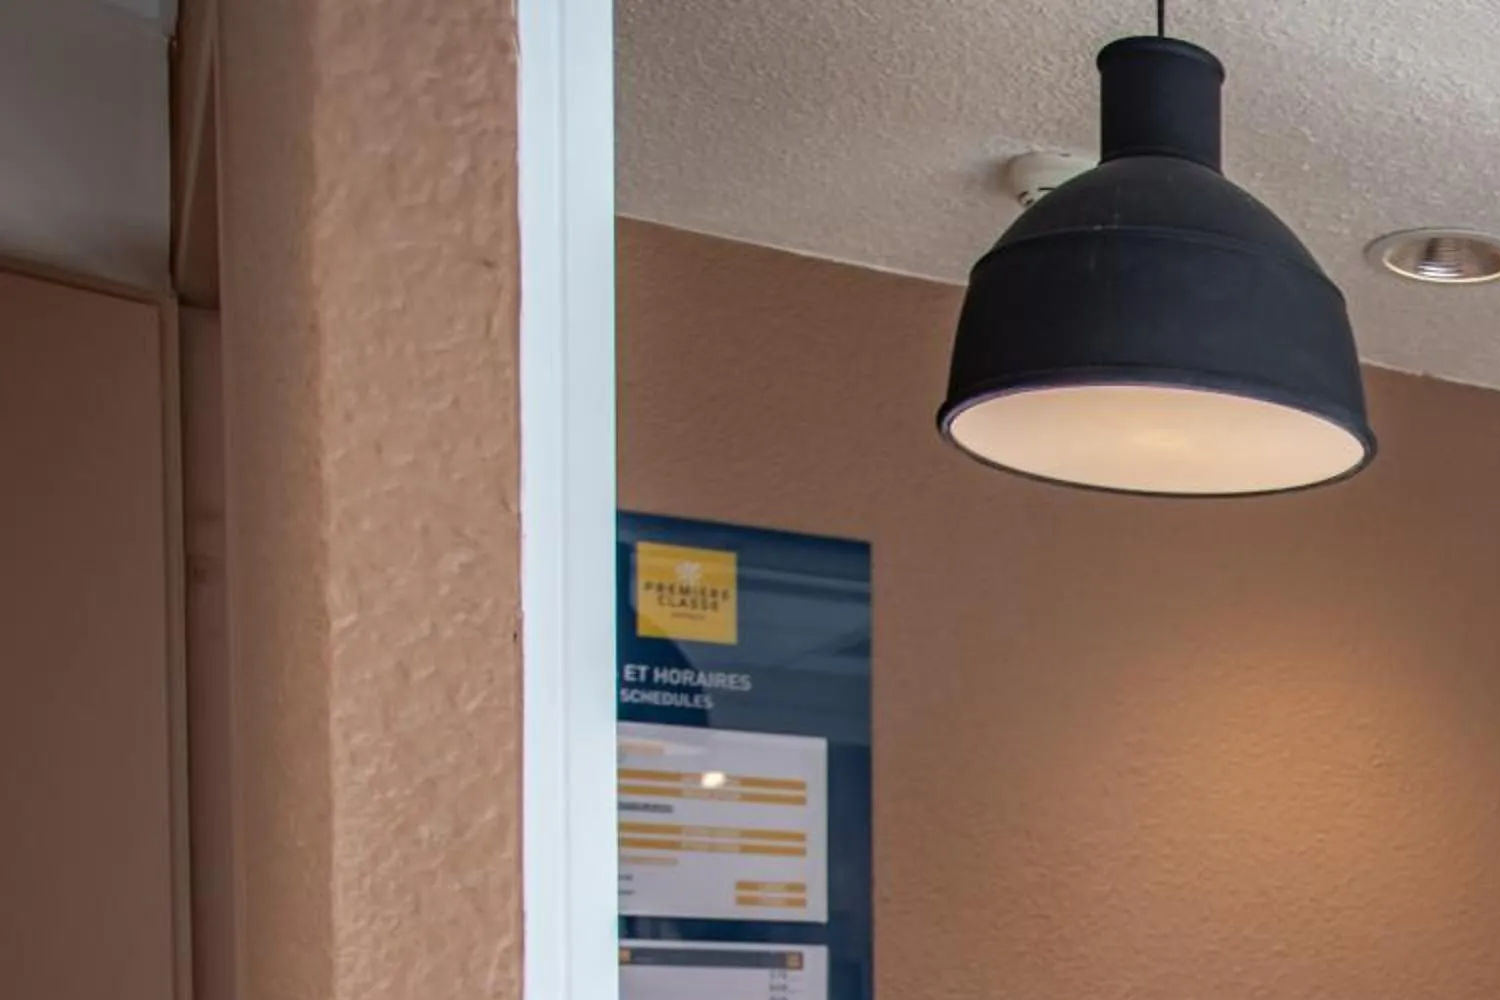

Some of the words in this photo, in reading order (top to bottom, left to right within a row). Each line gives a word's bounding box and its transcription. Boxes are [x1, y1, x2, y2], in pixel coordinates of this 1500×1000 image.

[657, 594, 718, 612] CLASSE
[624, 664, 649, 682] ET
[653, 666, 752, 692] HORAIRES
[621, 688, 714, 709] SCHEDULES
